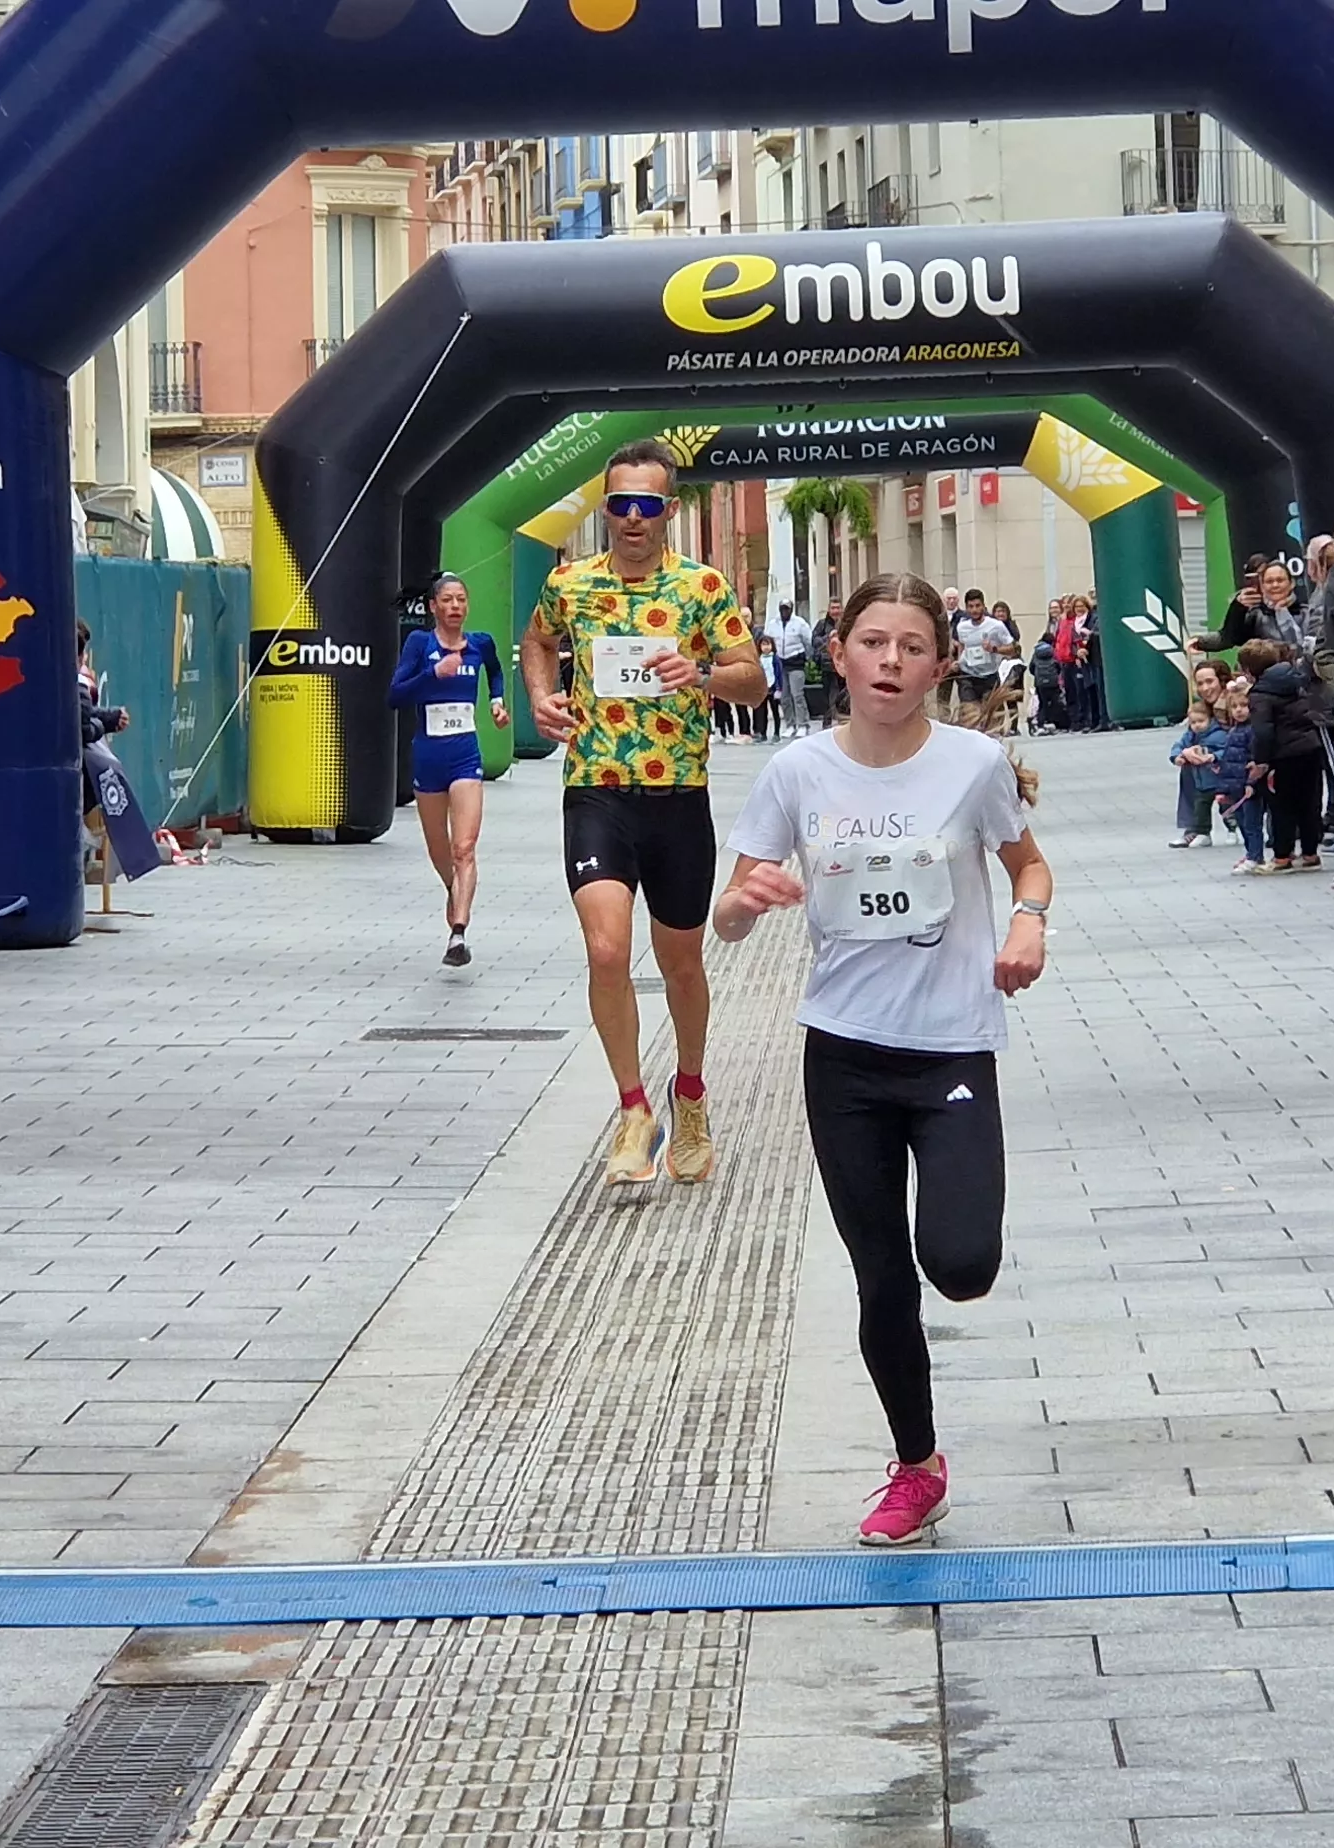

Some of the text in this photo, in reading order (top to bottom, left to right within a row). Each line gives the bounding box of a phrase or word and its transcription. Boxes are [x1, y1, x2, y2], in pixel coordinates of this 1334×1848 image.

[662, 242, 1020, 333] embou
[667, 341, 1020, 371] PÁSATE A LA OPERADORA ARAGONESA
[710, 434, 996, 466] CAJA RURAL DE ARAGÓN
[534, 463, 556, 481] La
[268, 637, 370, 666] embou
[620, 668, 652, 683] 576
[807, 812, 916, 838] BECAUSE
[859, 891, 910, 916] 580
